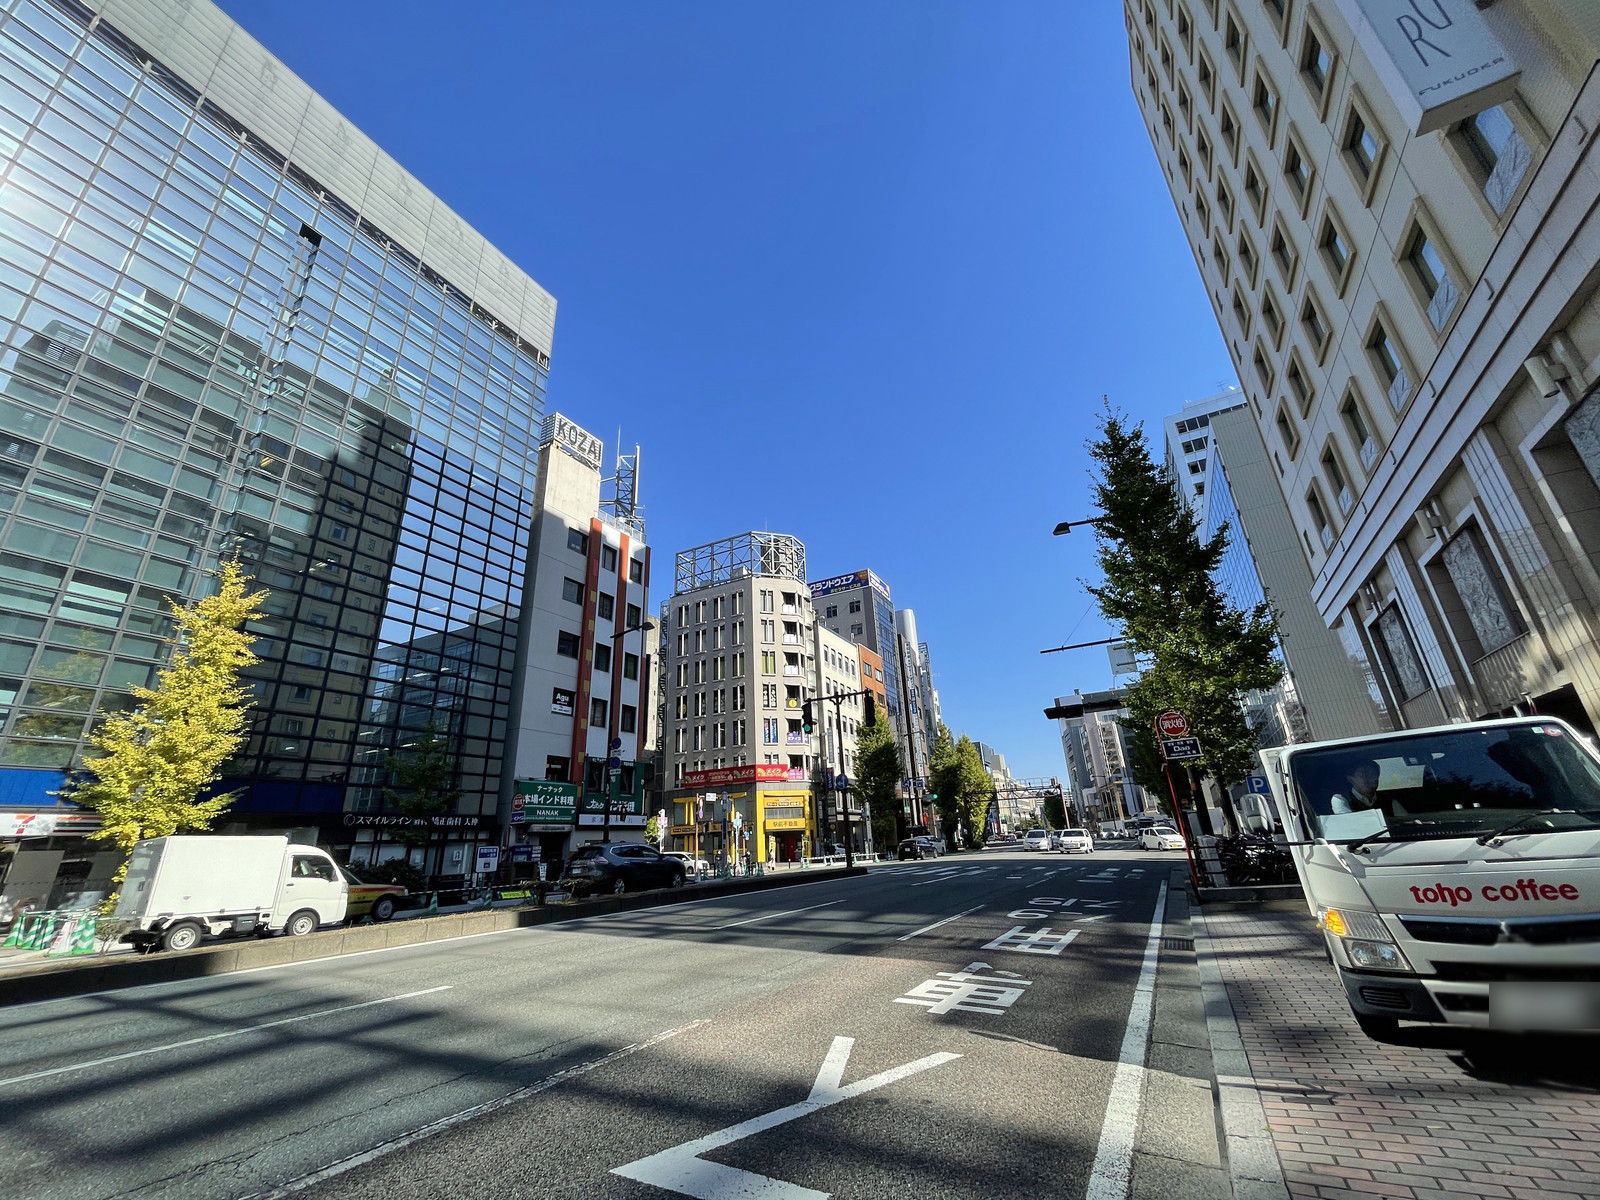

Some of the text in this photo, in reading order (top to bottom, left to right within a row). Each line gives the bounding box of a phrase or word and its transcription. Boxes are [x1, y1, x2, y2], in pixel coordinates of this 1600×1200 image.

[1418, 57, 1504, 96] FUKUOKA
[556, 692, 570, 702] Agu
[1161, 718, 1185, 730] 消火栓
[537, 785, 563, 793] ナーナック
[1253, 778, 1264, 792] P
[524, 794, 574, 806] 本場インド料理
[356, 816, 412, 825] スマイルライン
[1409, 879, 1579, 907] toho coffee
